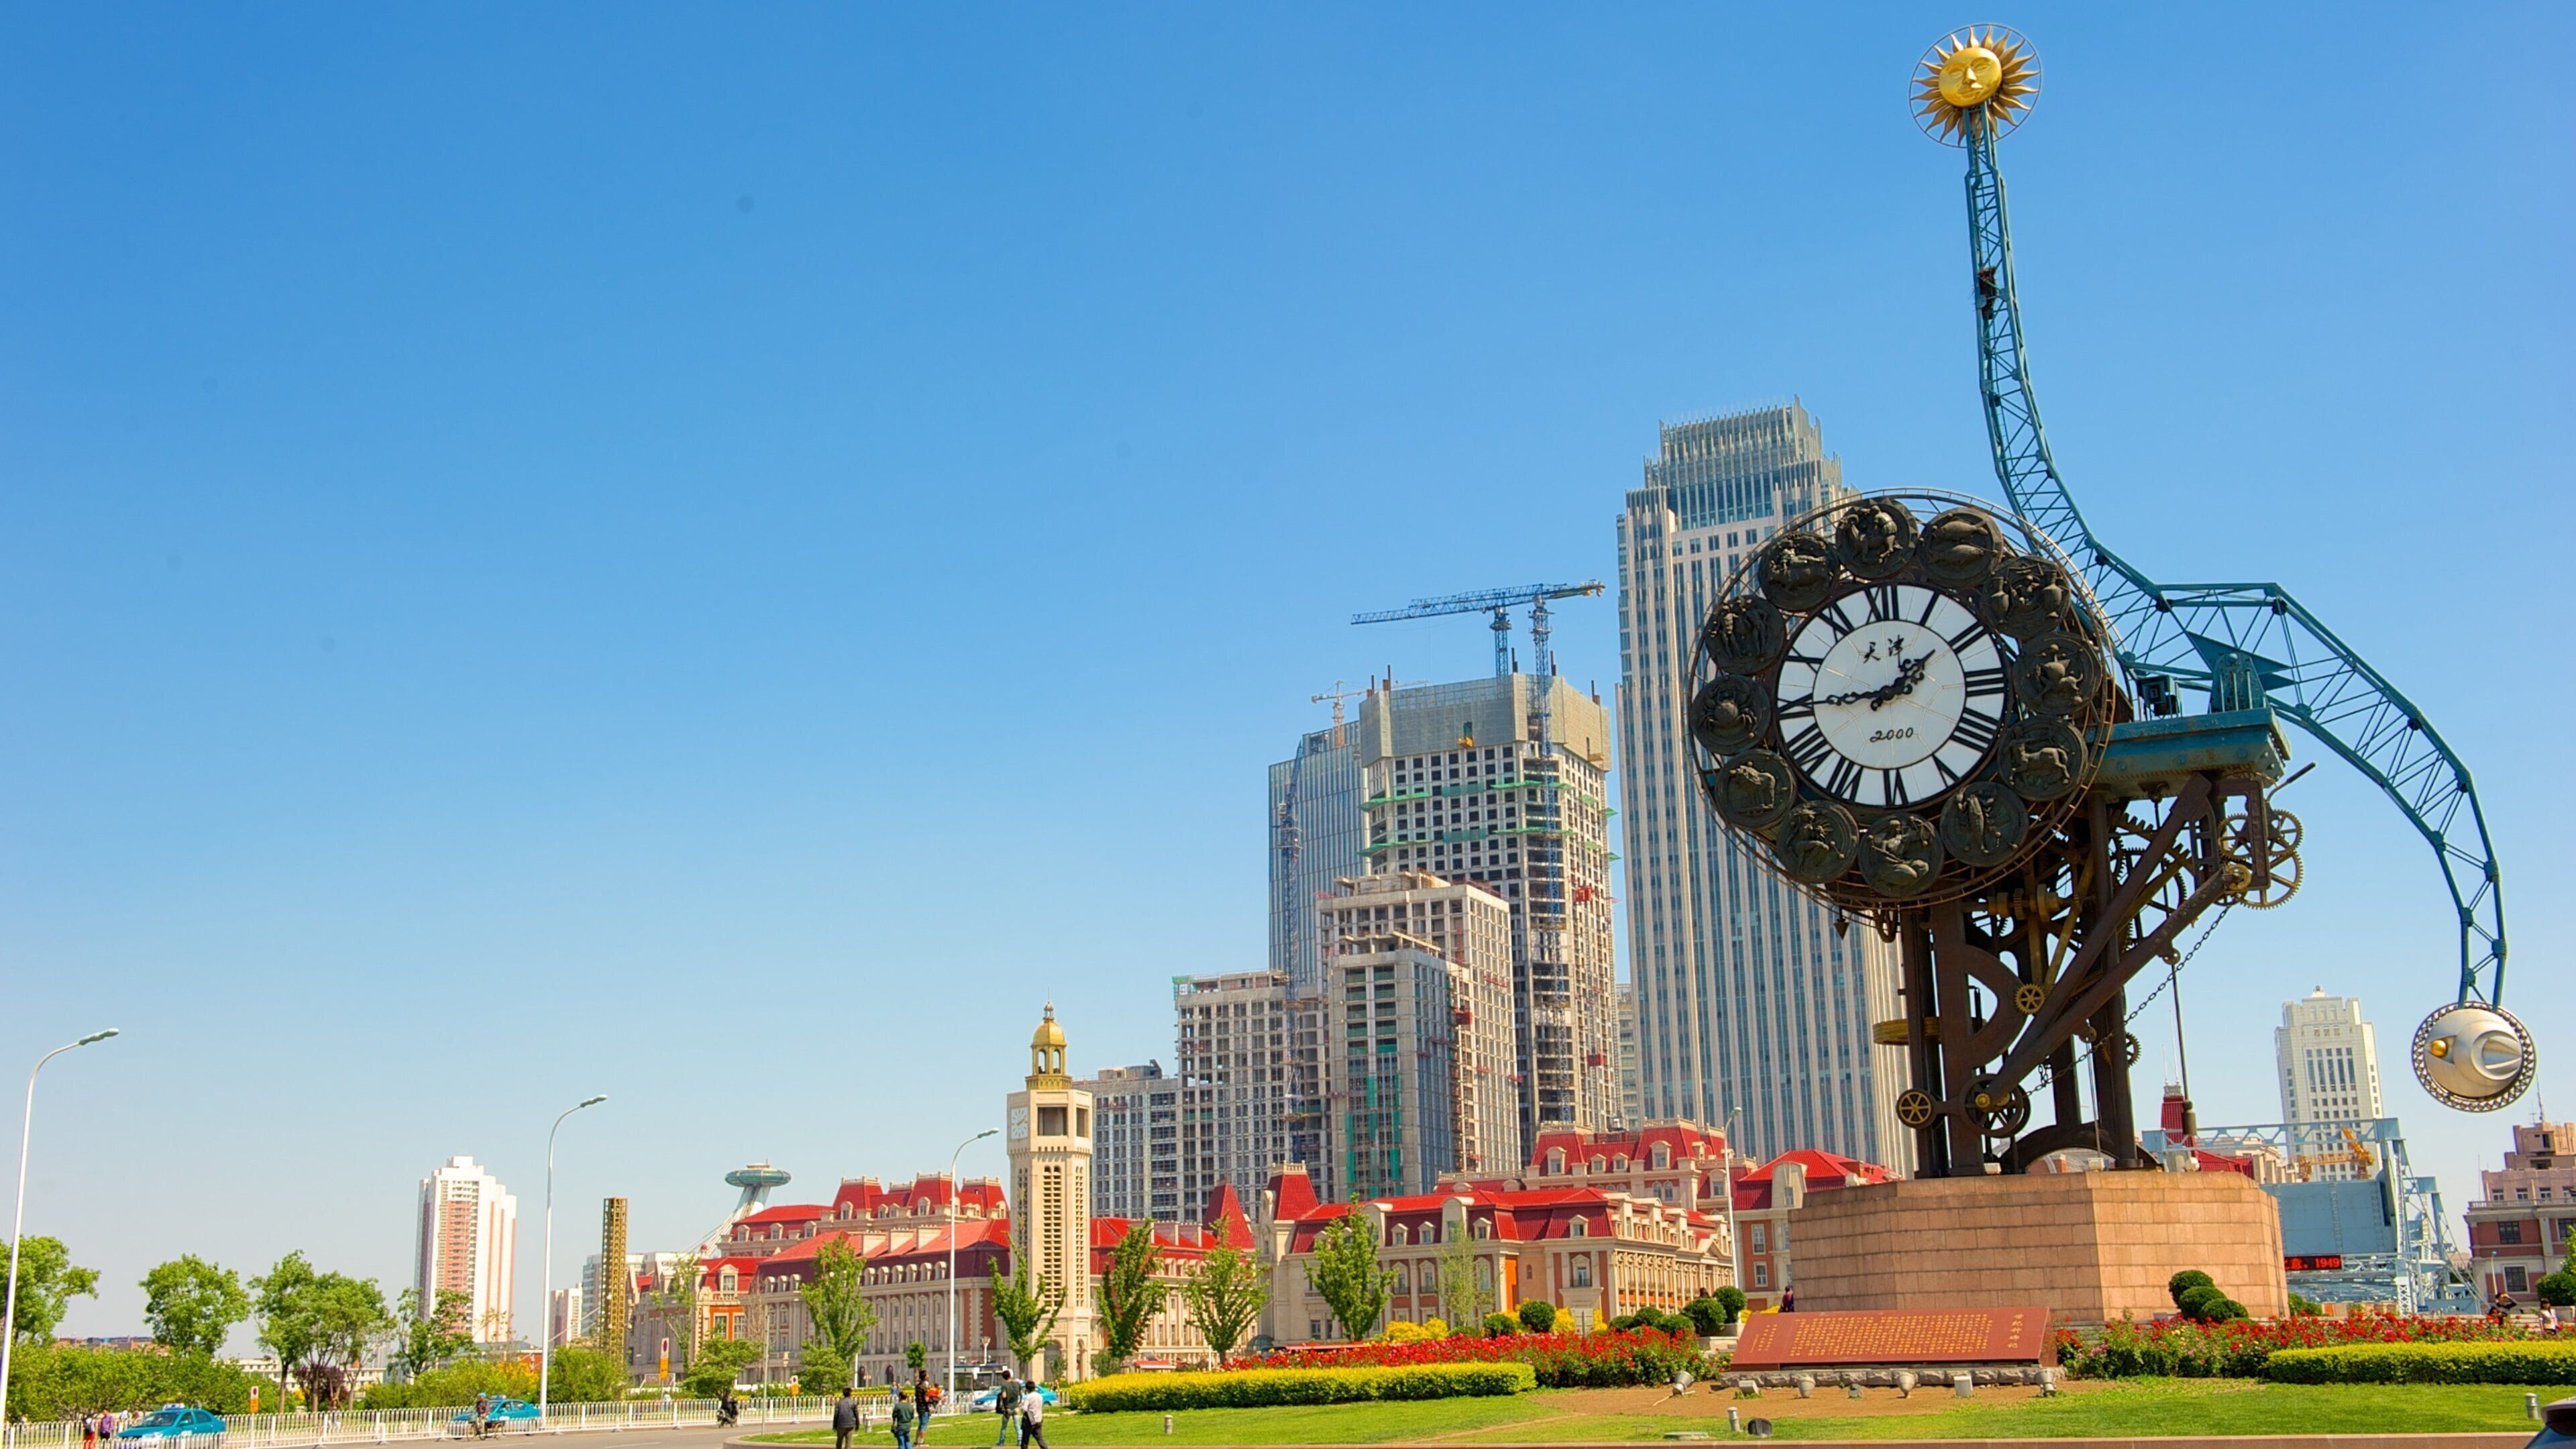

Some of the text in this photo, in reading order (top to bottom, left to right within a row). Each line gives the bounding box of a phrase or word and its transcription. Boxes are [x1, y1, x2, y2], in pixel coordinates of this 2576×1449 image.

[1864, 585, 1899, 625] XII
[1919, 591, 1940, 627] I
[1817, 604, 1854, 643] XI
[1946, 621, 1990, 653] II
[1787, 647, 1824, 673] X
[1863, 635, 1904, 667] 天津
[1965, 668, 2004, 697] III
[1778, 694, 1814, 720] IX
[1870, 727, 1914, 743] 2000
[1949, 707, 1998, 752] IIII
[1786, 722, 1833, 774] VIII
[1827, 756, 1863, 802] VII
[1883, 769, 1909, 805] VI
[1932, 753, 1960, 788] V
[2315, 1257, 2340, 1269] 1949
